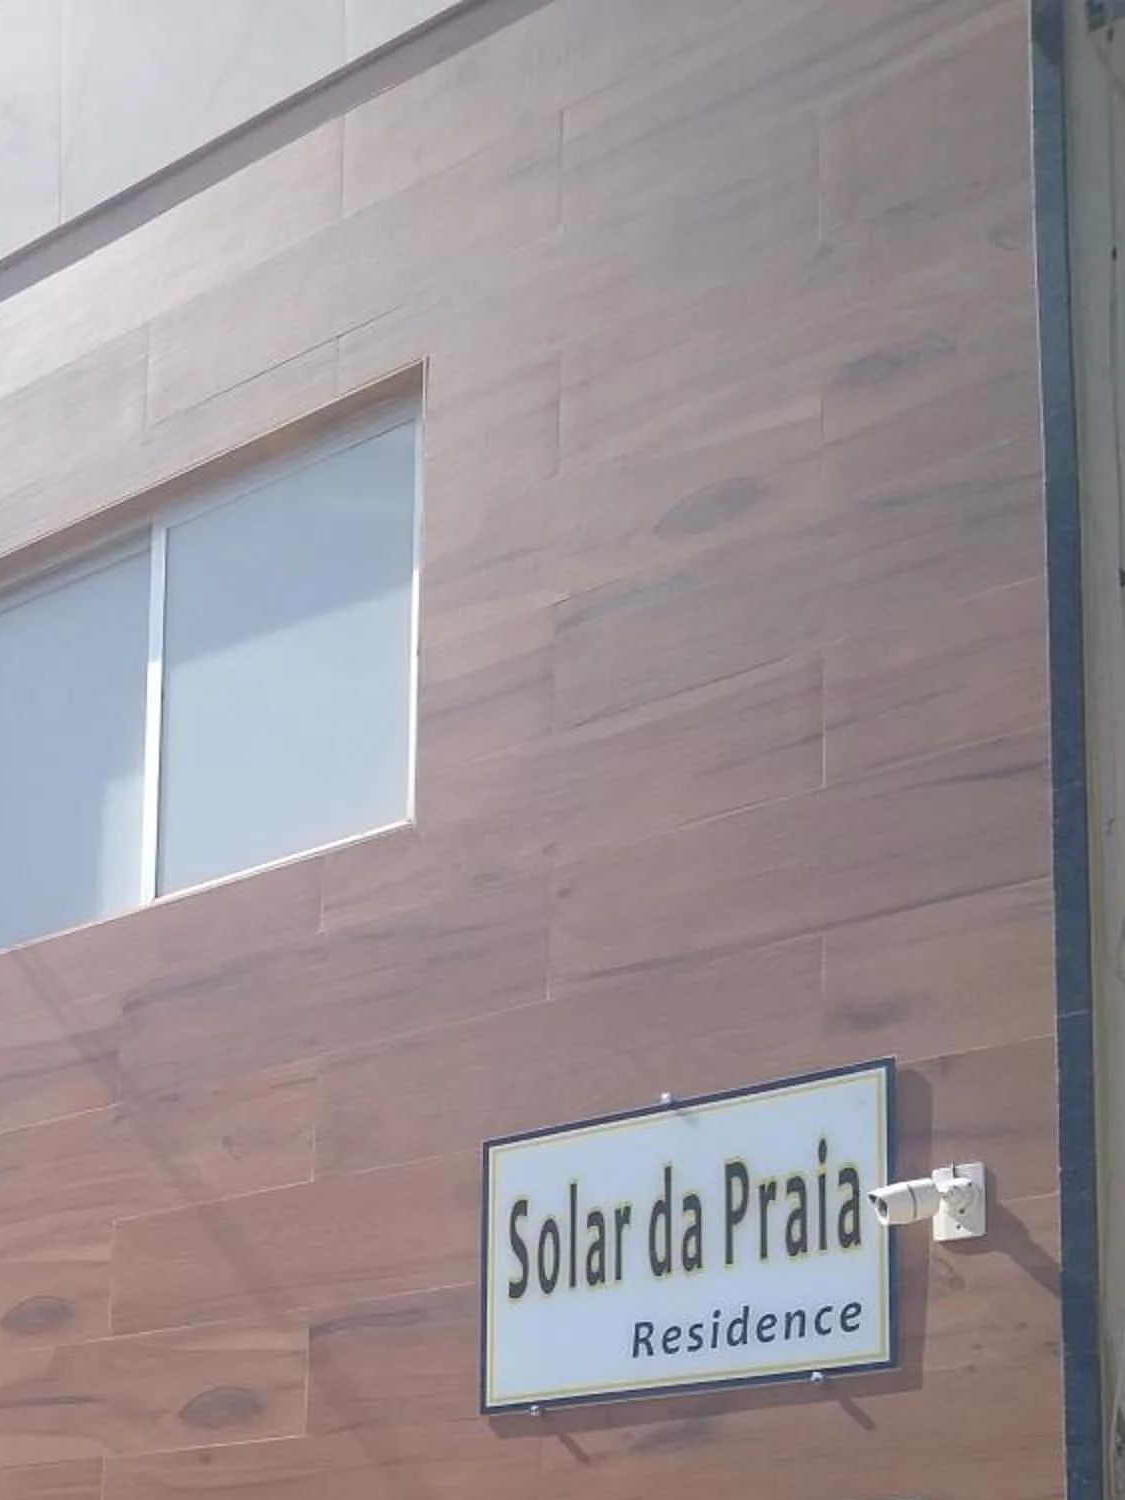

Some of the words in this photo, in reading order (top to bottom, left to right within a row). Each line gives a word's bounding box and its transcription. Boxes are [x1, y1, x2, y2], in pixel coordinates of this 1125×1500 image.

[508, 1182, 632, 1299] Solar
[648, 1164, 703, 1277] da
[724, 1137, 862, 1265] Praia
[632, 1300, 863, 1358] Residence
